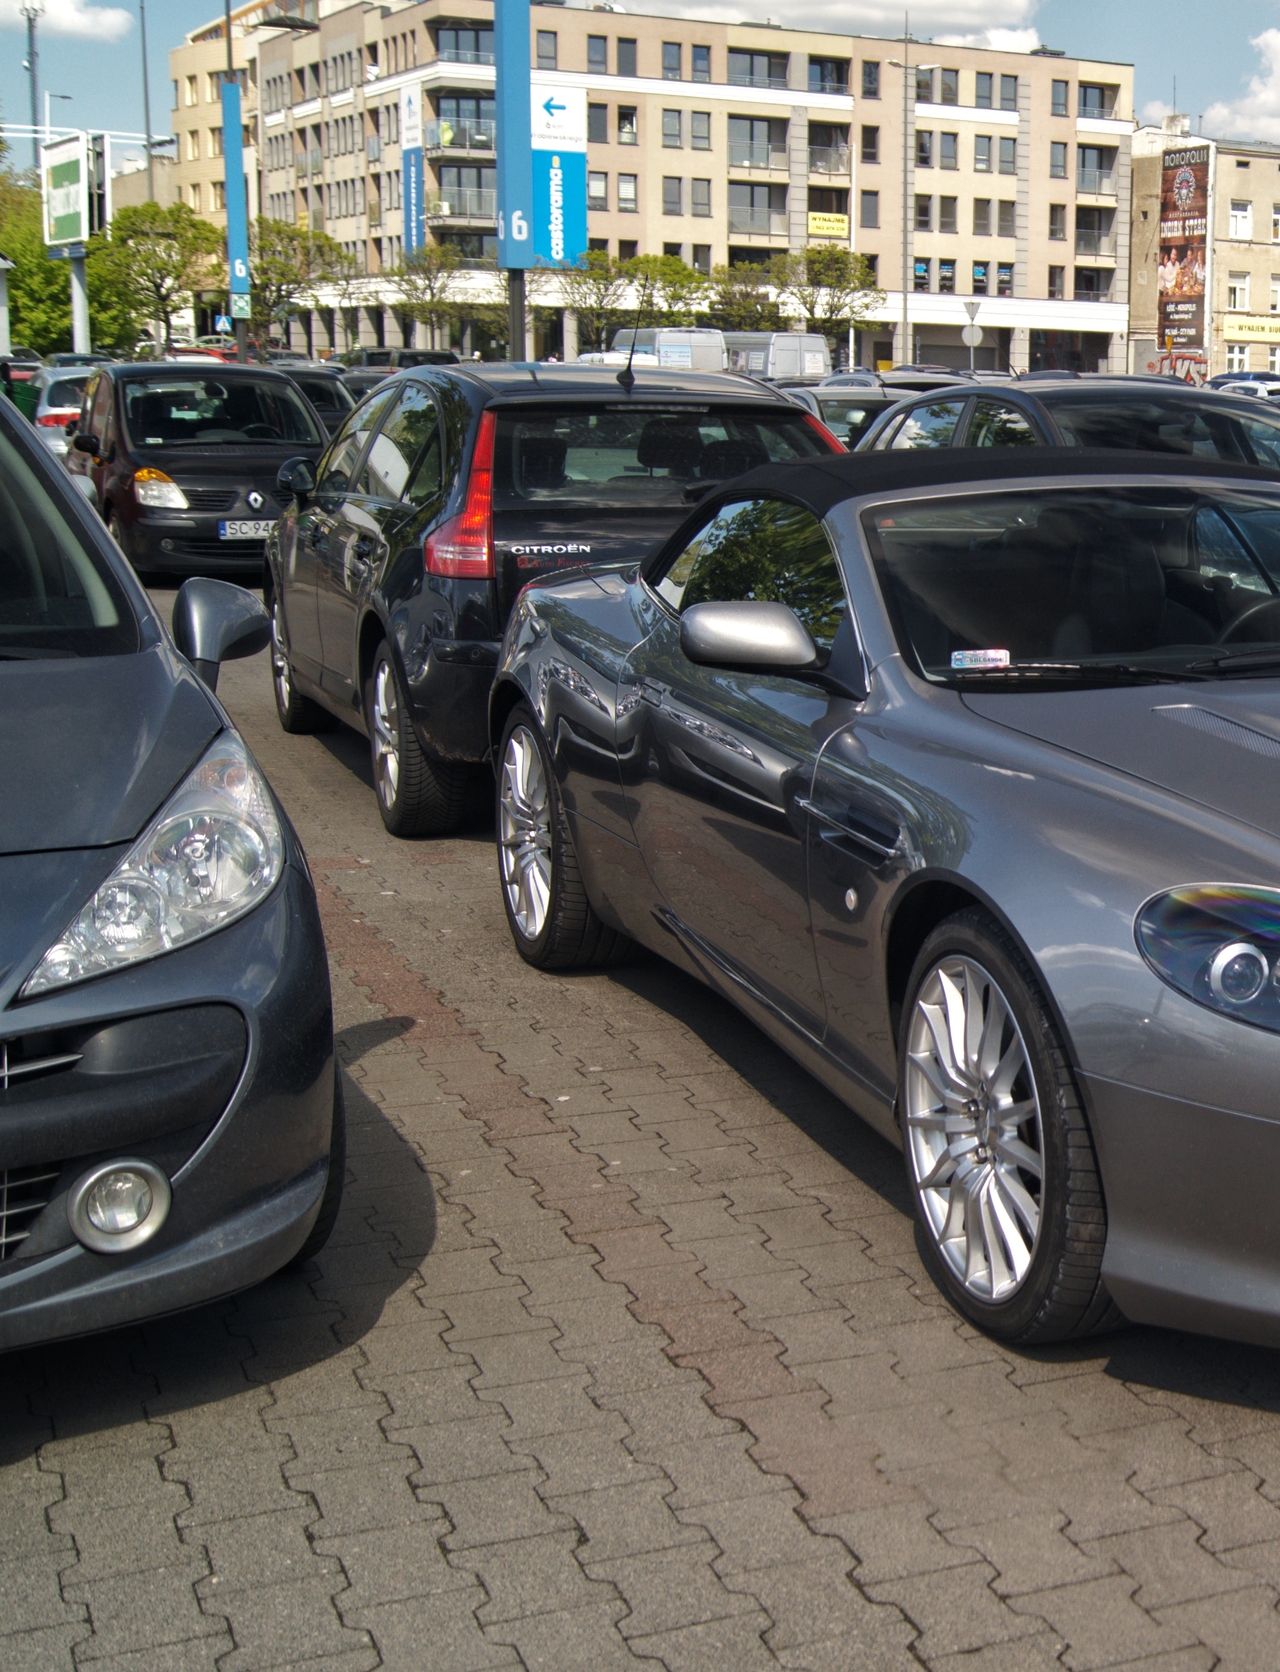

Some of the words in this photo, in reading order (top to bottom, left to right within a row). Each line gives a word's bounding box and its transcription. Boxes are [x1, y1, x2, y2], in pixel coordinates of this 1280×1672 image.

[1164, 149, 1207, 167] MONOPOLIS
[548, 168, 564, 260] castorama
[511, 210, 528, 241] 6
[1185, 218, 1206, 237] STEAK
[234, 258, 247, 277] 6
[228, 521, 249, 535] SC
[253, 521, 271, 535] 94
[511, 543, 591, 554] CITROËN
